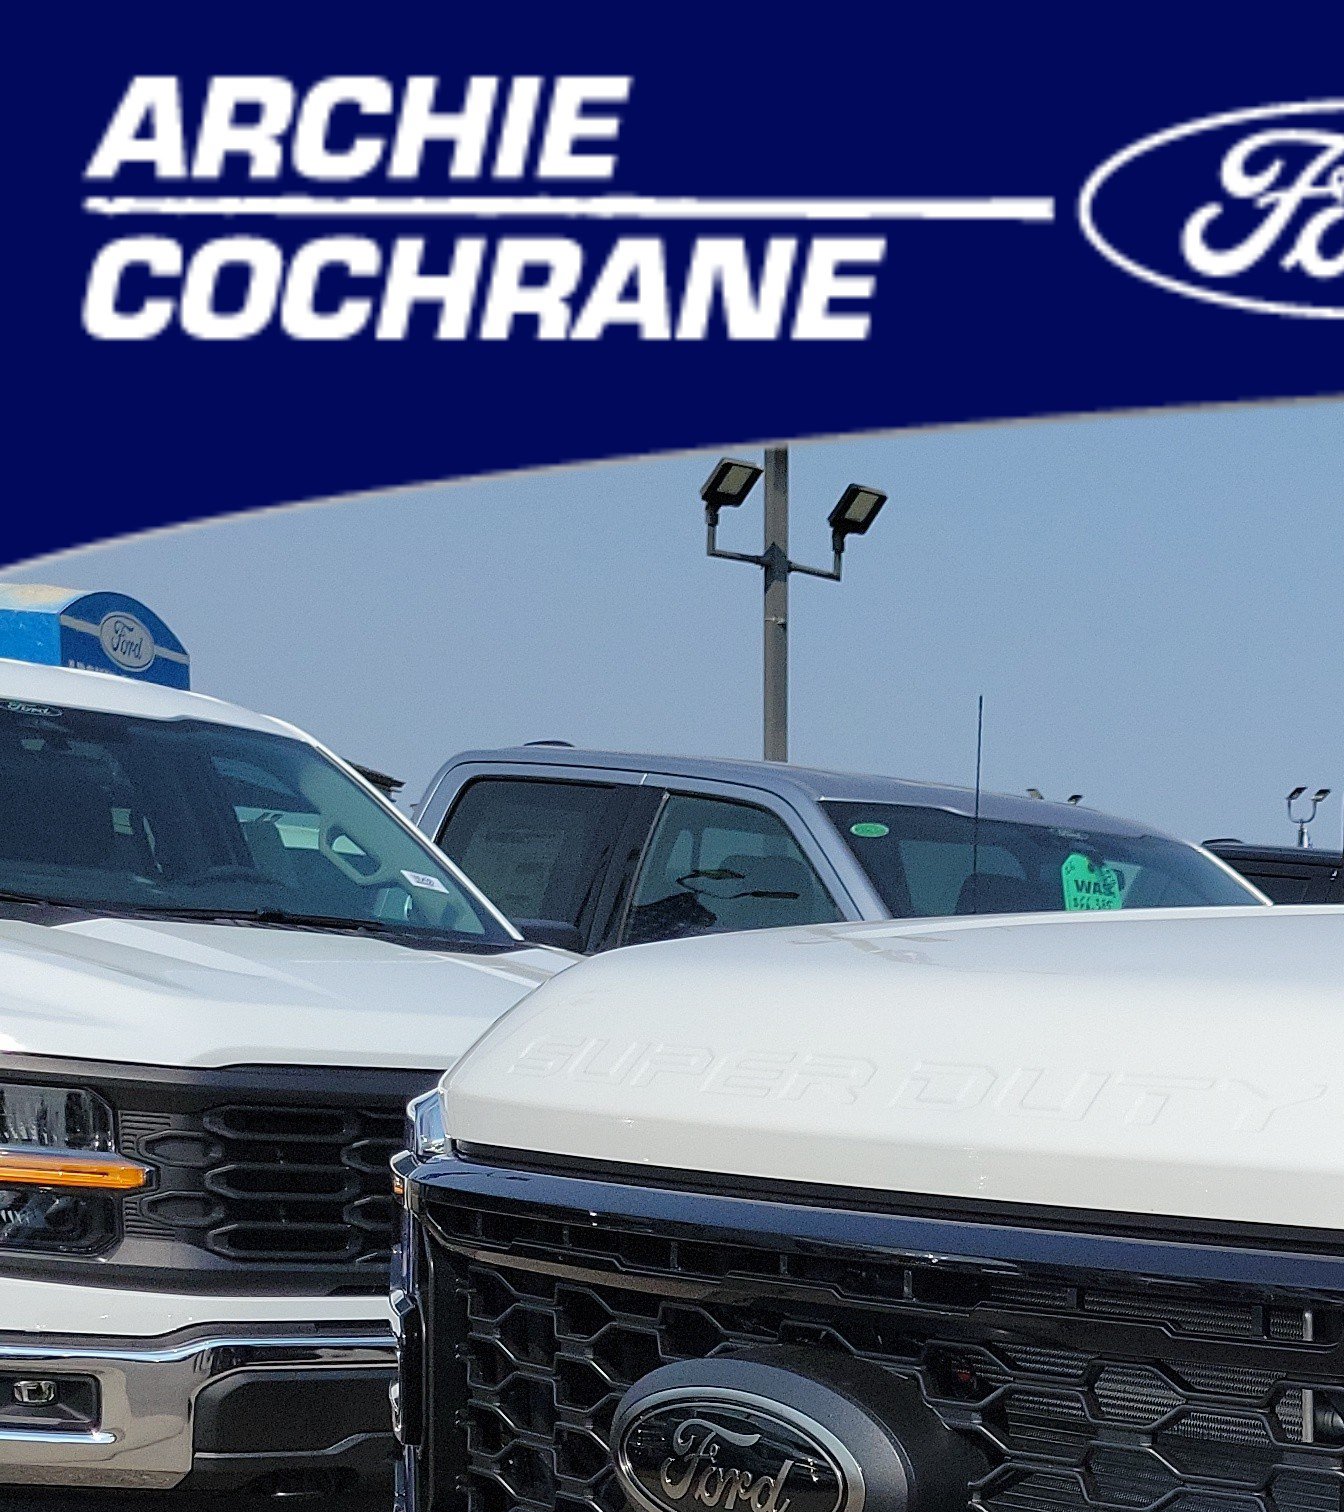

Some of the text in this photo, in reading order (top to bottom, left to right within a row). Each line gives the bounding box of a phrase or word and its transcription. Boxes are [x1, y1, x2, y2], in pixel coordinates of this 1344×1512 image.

[111, 620, 144, 660] Ford
[507, 1033, 1330, 1134] SUPER DUTY
